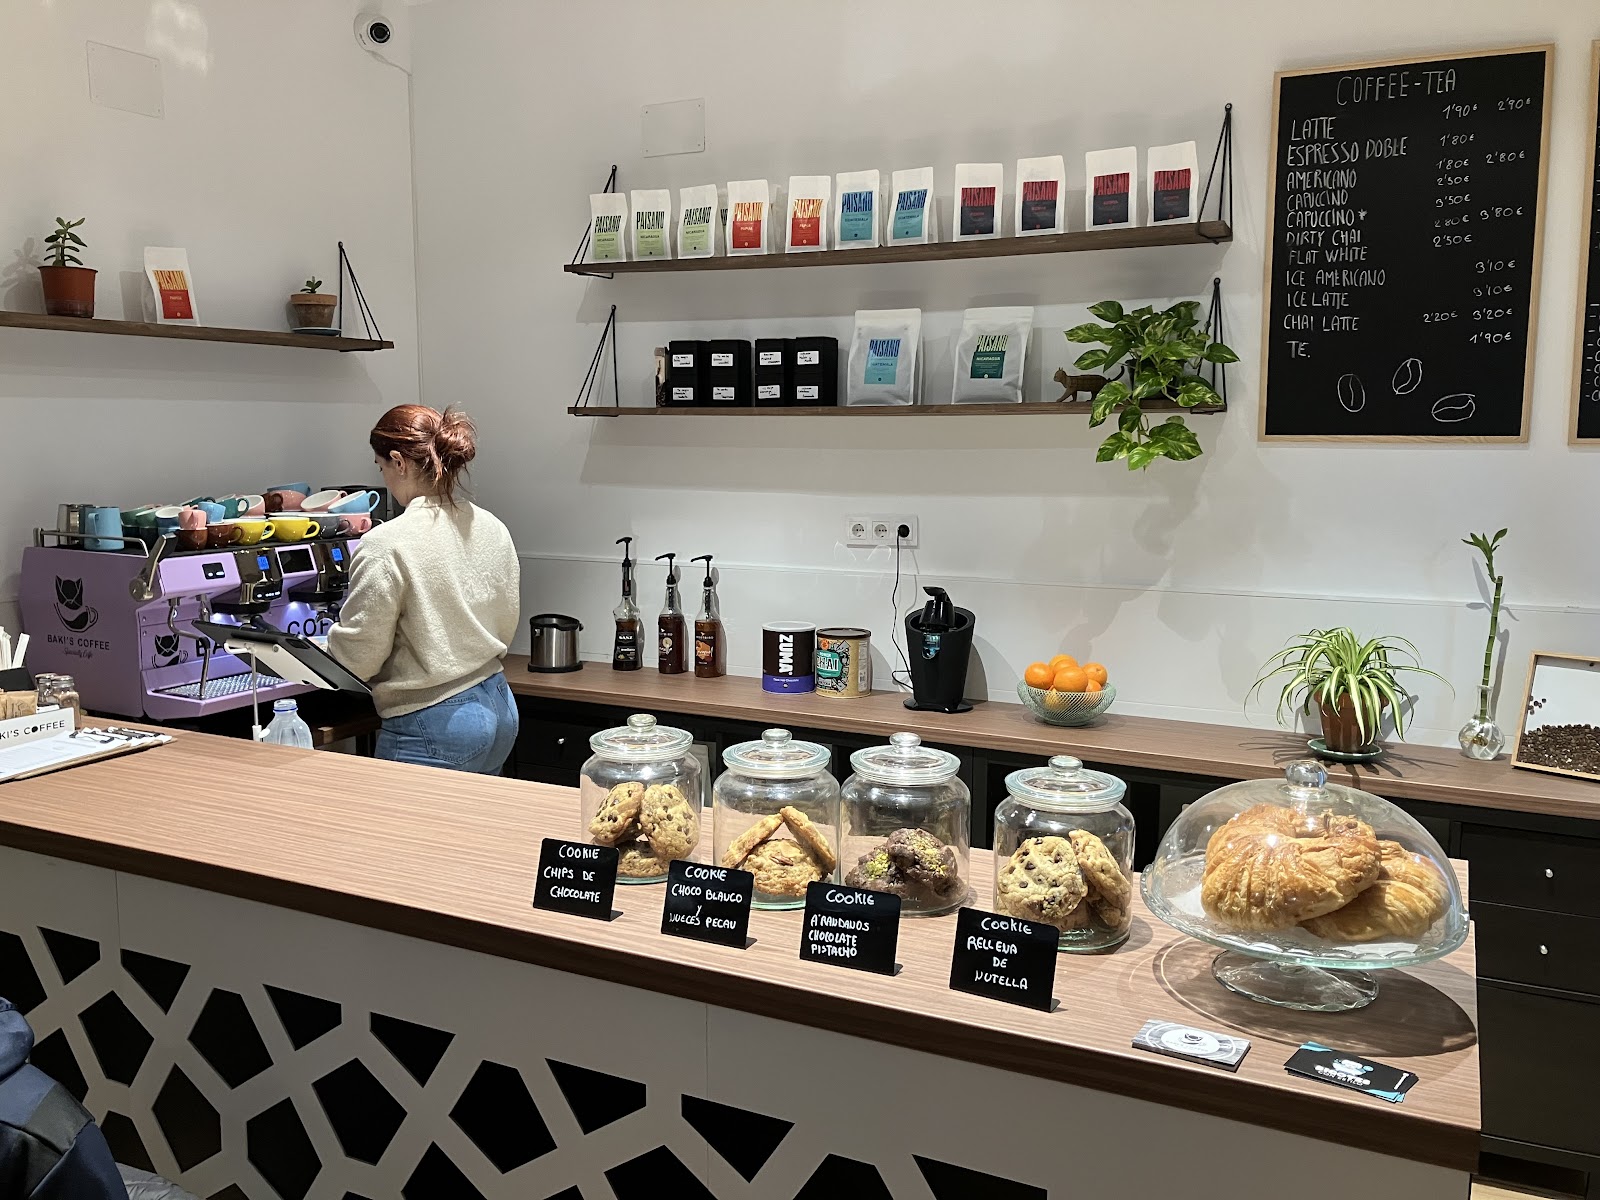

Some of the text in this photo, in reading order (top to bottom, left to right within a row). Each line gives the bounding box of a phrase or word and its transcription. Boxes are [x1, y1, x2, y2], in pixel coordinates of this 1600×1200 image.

[1291, 116, 1336, 140] LATTE
[1287, 136, 1408, 166] ESPRESSO DOBLE
[1286, 168, 1357, 192] AMERICANO
[794, 199, 824, 218] PAISANO
[842, 190, 873, 213] PAISANO
[896, 189, 928, 211] PAISANO
[1287, 190, 1348, 212] CAPUCCINO
[636, 211, 665, 229] PAISANO
[683, 207, 711, 226] PAISANO
[734, 202, 763, 221] PAISANO
[595, 215, 621, 233] PAISANO
[1286, 229, 1361, 248] DIRTY CHAI
[1289, 246, 1368, 266] FLAT WHITE
[1286, 269, 1386, 288] ICE AMERICANO
[1287, 291, 1349, 309] ICE LATTE
[1283, 315, 1360, 332] CHAI LATTE
[870, 340, 900, 357] PAISANO
[976, 335, 1008, 352] PAISANO
[48, 634, 110, 650] BAKI'S COFFEE
[779, 634, 794, 673] ZUMA
[0, 729, 20, 739] KI'S
[559, 844, 600, 859] COOKIE
[544, 866, 596, 881] CHIPS DE
[685, 866, 727, 881] COOKIE
[550, 886, 601, 902] CHOCOLATE
[671, 884, 701, 896] CHOCO
[808, 930, 857, 947] CHOCOLATE
[811, 944, 857, 958] PISTACHO
[993, 957, 1008, 968] DE
